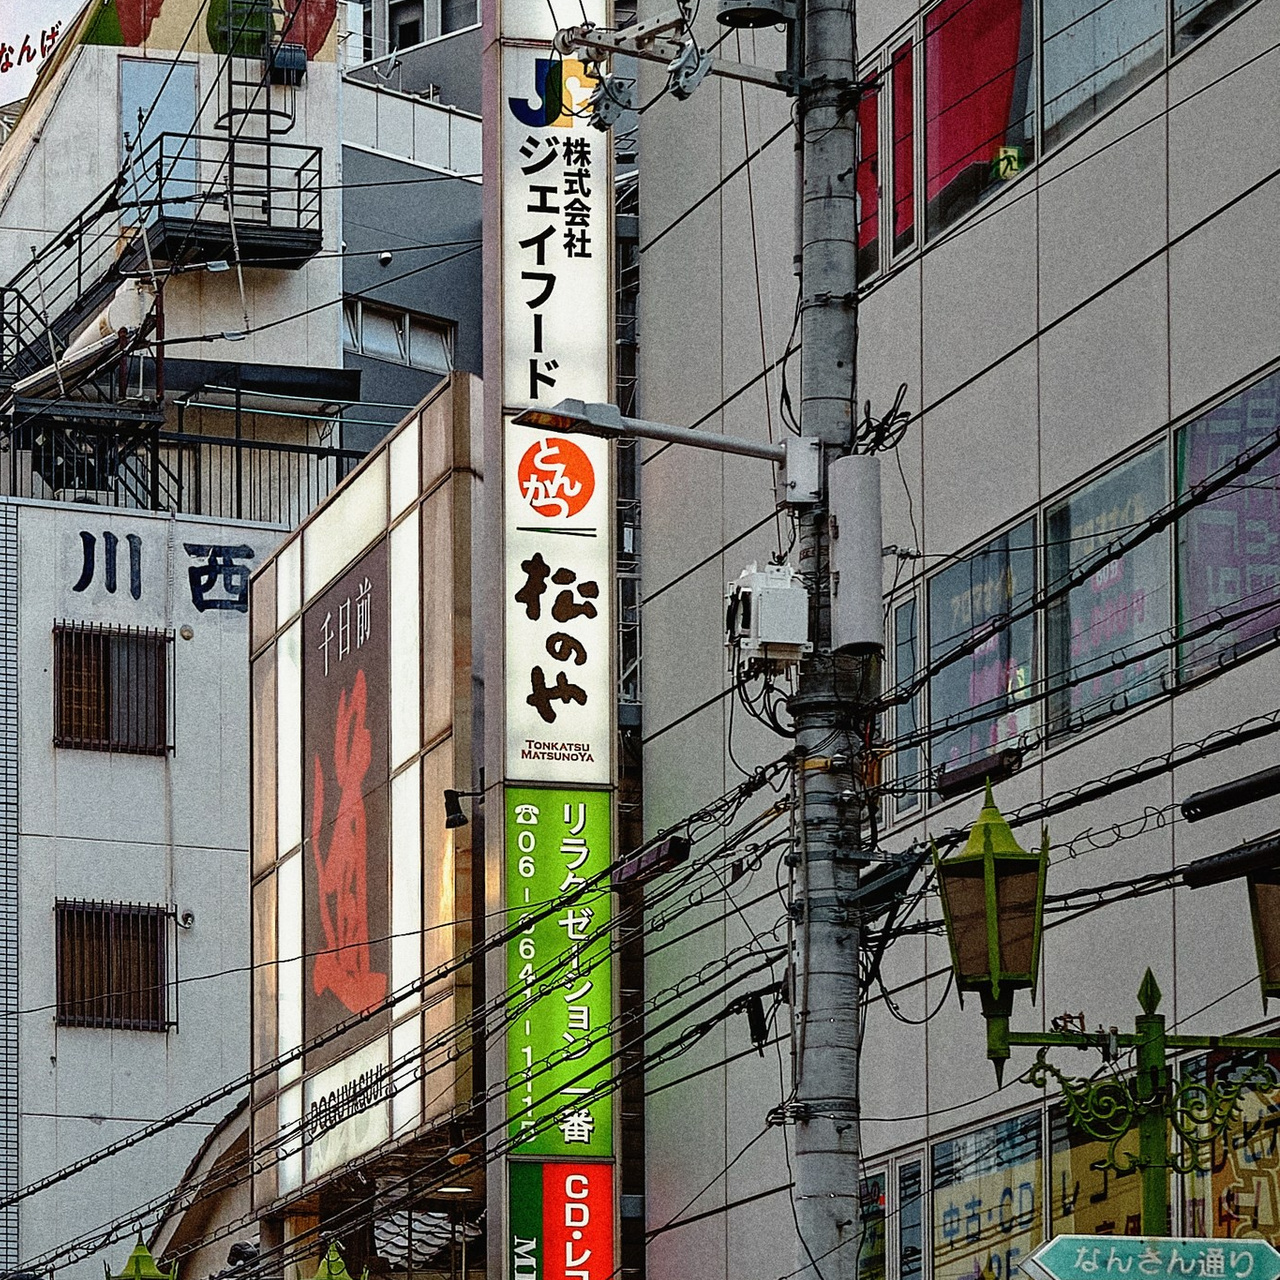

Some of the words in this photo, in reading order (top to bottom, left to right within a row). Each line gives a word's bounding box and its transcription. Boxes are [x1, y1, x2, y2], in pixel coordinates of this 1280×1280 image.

[563, 137, 592, 259] 株式会社
[522, 438, 582, 518] とんかつ
[317, 576, 373, 677] 千日前
[525, 739, 590, 752] TONKATSU
[1073, 1246, 1255, 1279] なんさん通り
